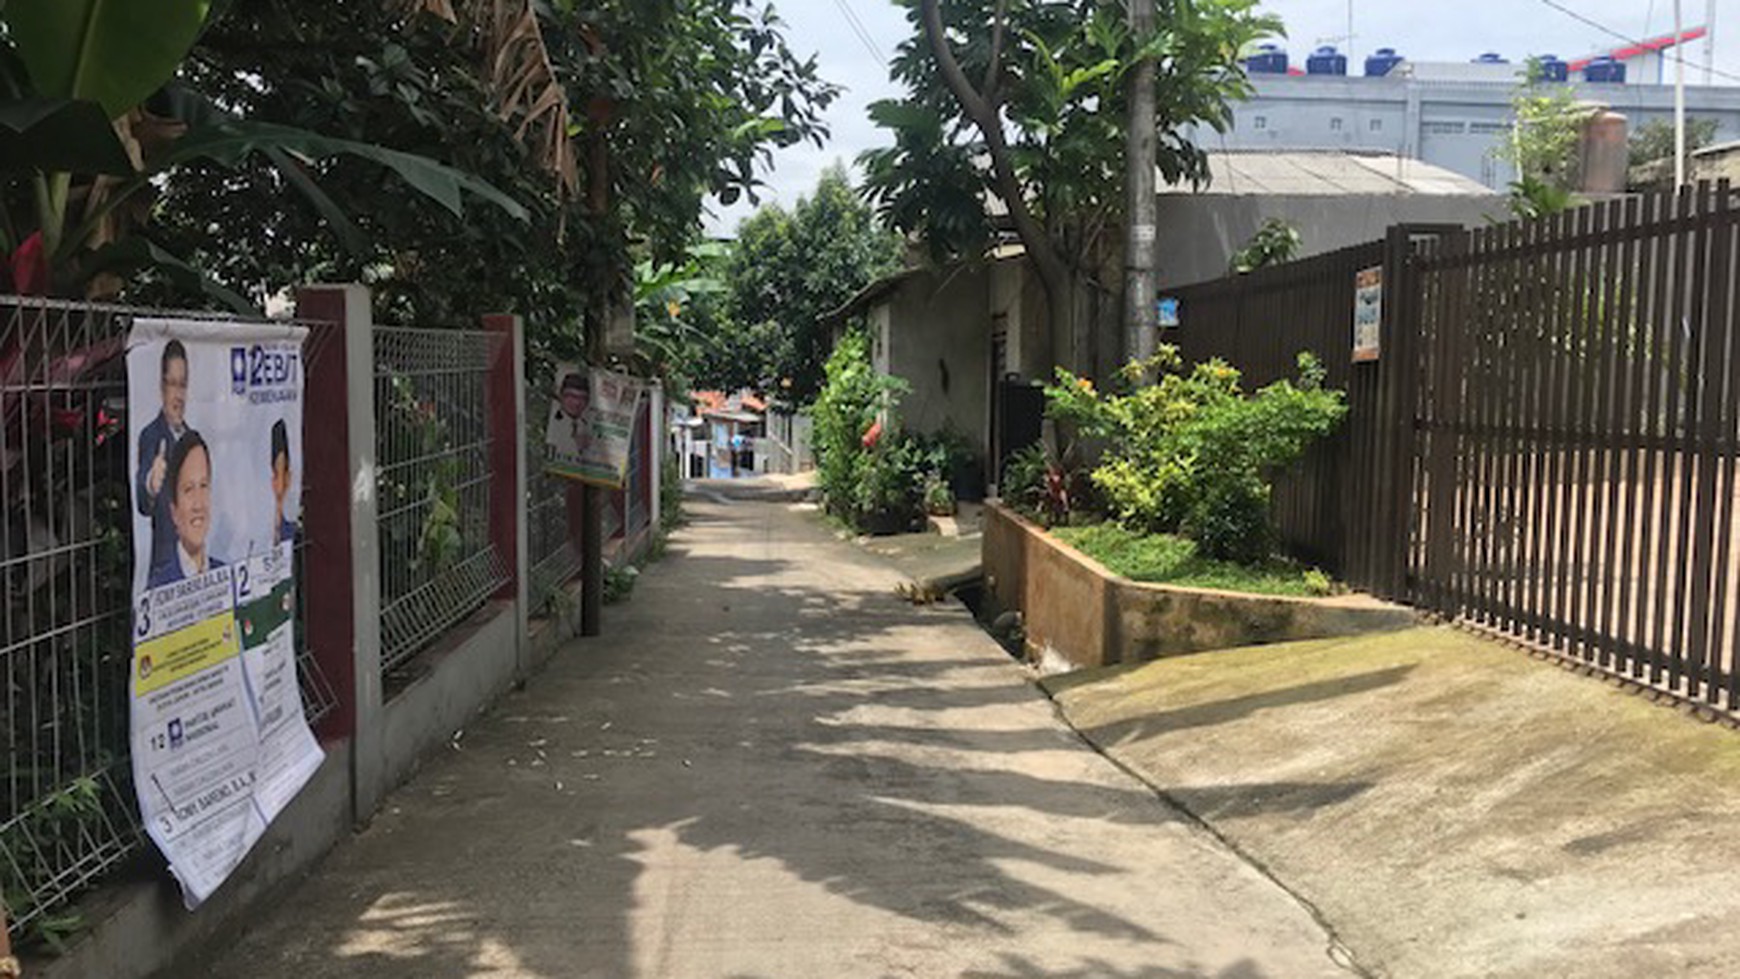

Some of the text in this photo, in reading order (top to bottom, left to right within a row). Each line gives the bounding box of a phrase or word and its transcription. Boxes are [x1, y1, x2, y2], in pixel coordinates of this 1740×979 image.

[239, 565, 251, 598] 2
[138, 597, 151, 637] 3
[160, 816, 173, 834] 3
